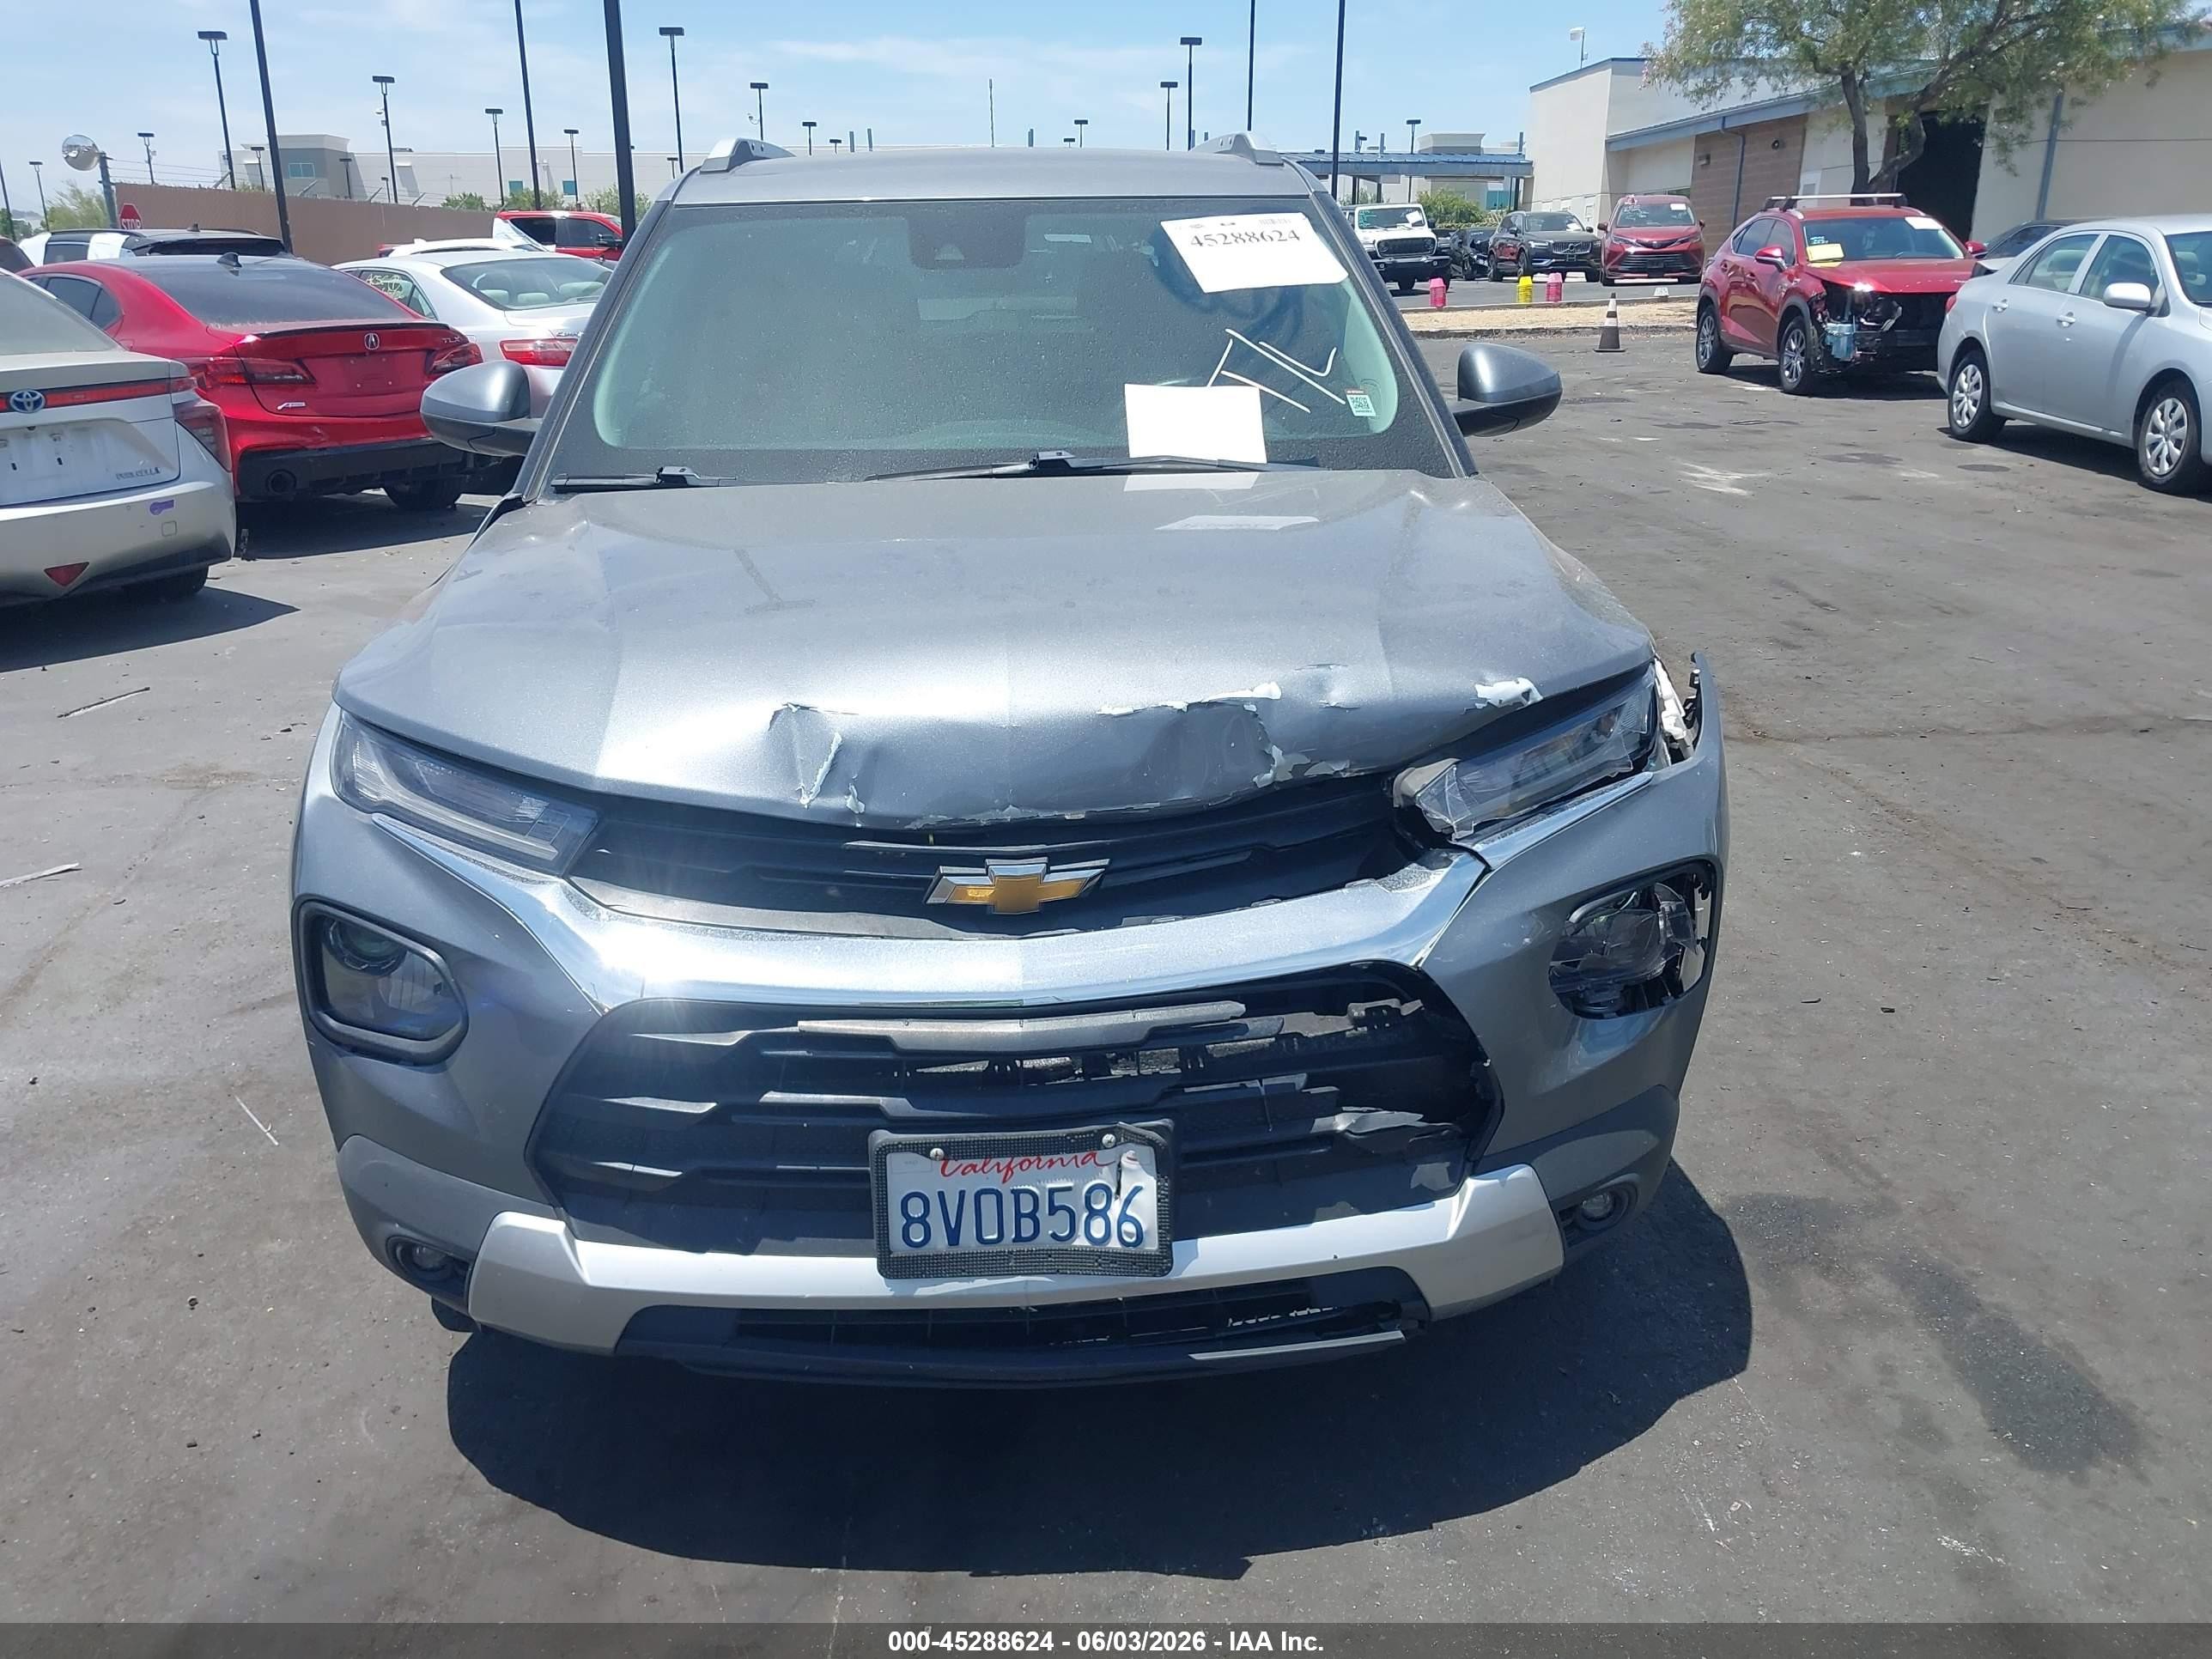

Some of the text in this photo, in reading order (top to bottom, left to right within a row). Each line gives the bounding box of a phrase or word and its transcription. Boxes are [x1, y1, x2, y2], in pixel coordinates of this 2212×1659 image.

[122, 218, 141, 230] STOP
[1190, 228, 1301, 248] 45288624
[940, 1150, 1116, 1184] California
